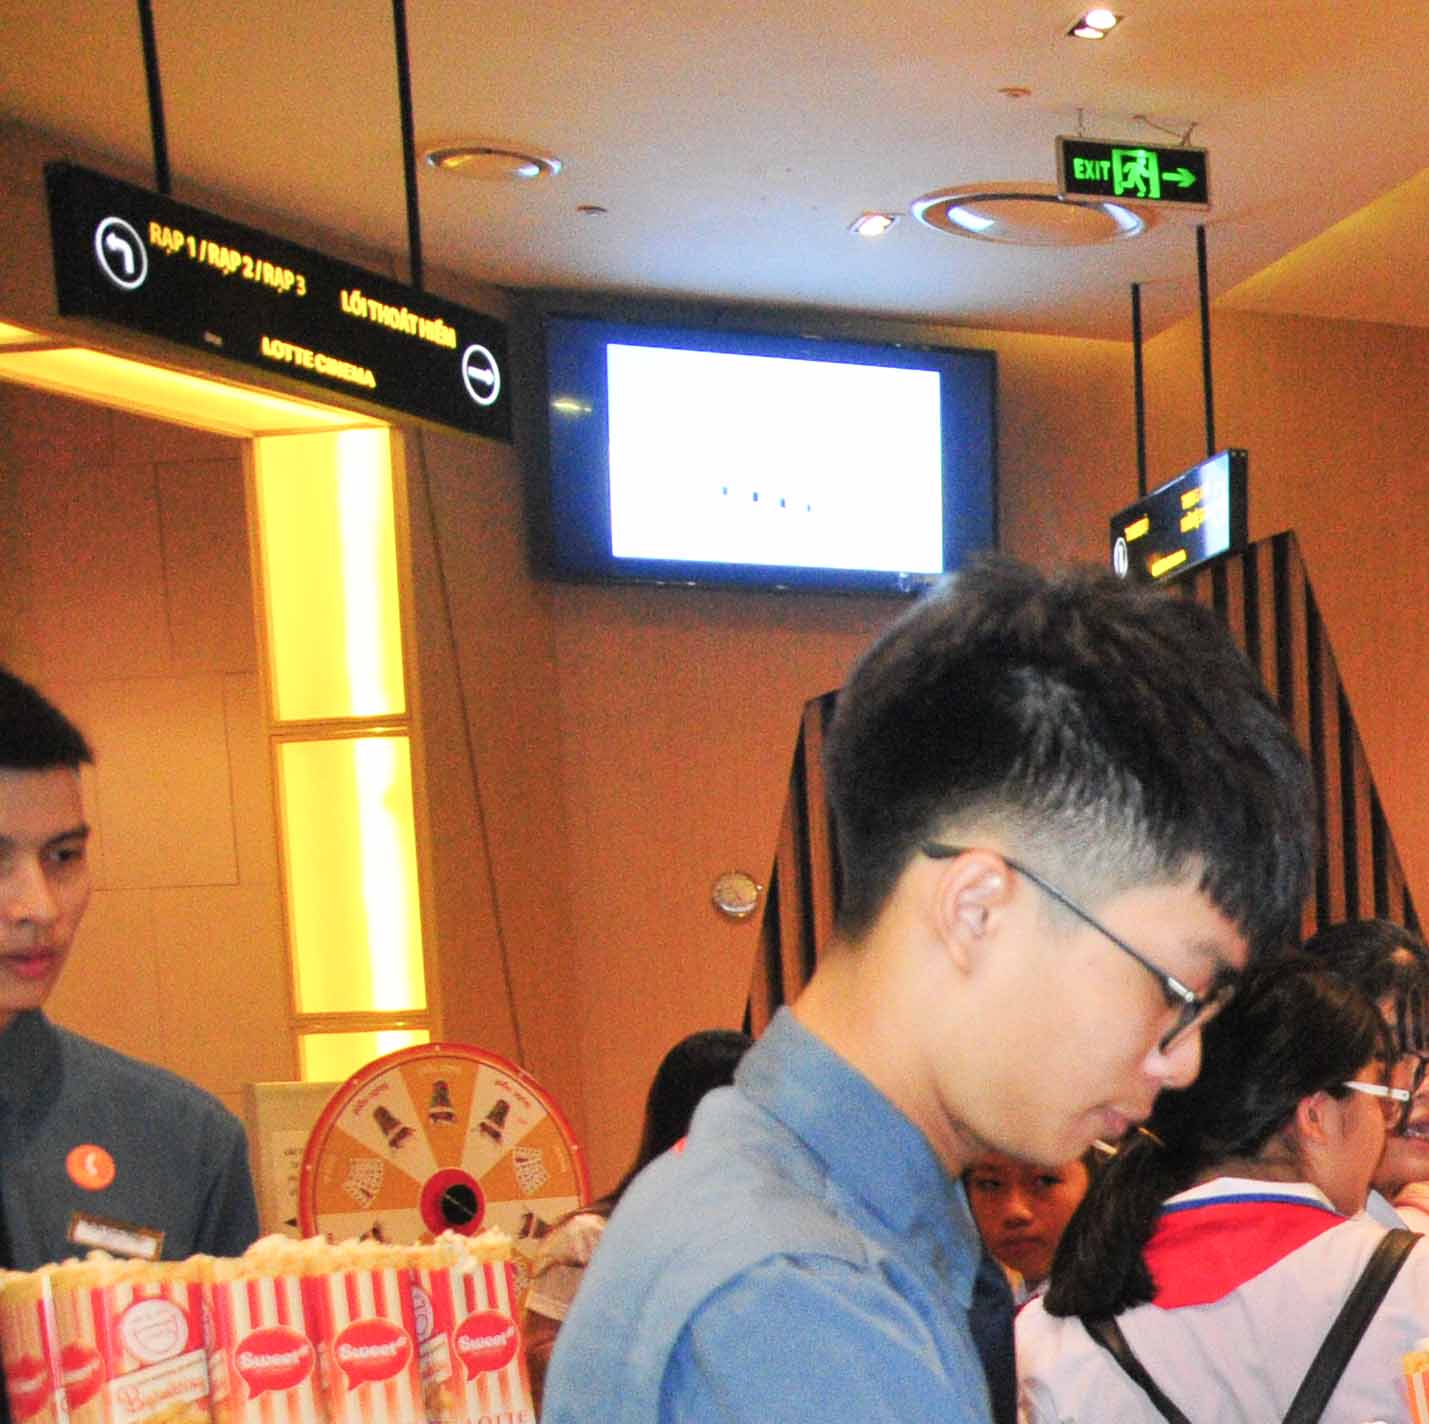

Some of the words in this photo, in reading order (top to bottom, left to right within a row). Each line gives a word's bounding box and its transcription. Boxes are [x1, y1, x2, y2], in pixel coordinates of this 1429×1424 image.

[1073, 157, 1110, 181] EXIT
[149, 221, 184, 255] RẠP
[187, 235, 196, 259] 1
[207, 243, 241, 275] RẠP
[242, 256, 254, 279] 2
[262, 263, 295, 293] RẠP
[296, 274, 307, 296] 3
[261, 335, 315, 369] LOTTE
[314, 352, 377, 389] CINEMA
